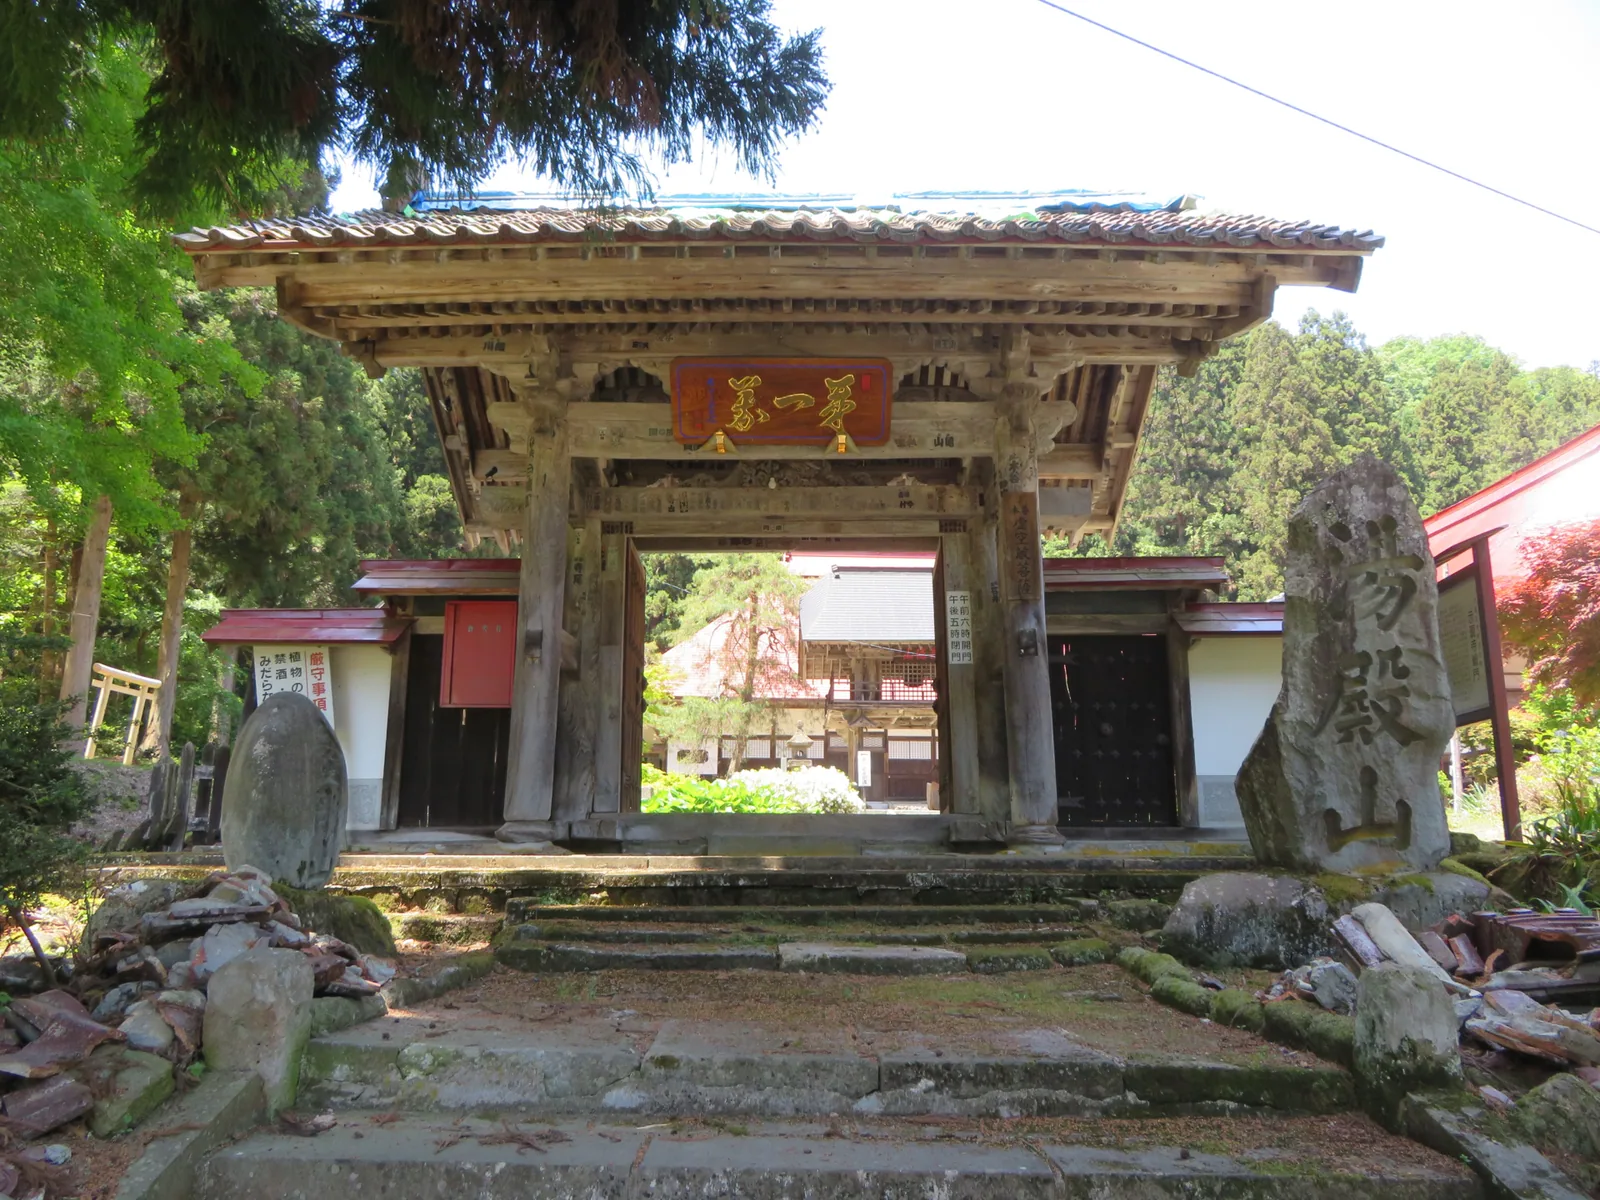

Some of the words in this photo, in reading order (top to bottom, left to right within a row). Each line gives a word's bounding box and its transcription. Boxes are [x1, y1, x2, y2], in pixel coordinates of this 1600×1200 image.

[949, 595, 961, 662] 午後五時閉門
[960, 595, 972, 662] 午前六時開門
[289, 651, 303, 692] 植物の
